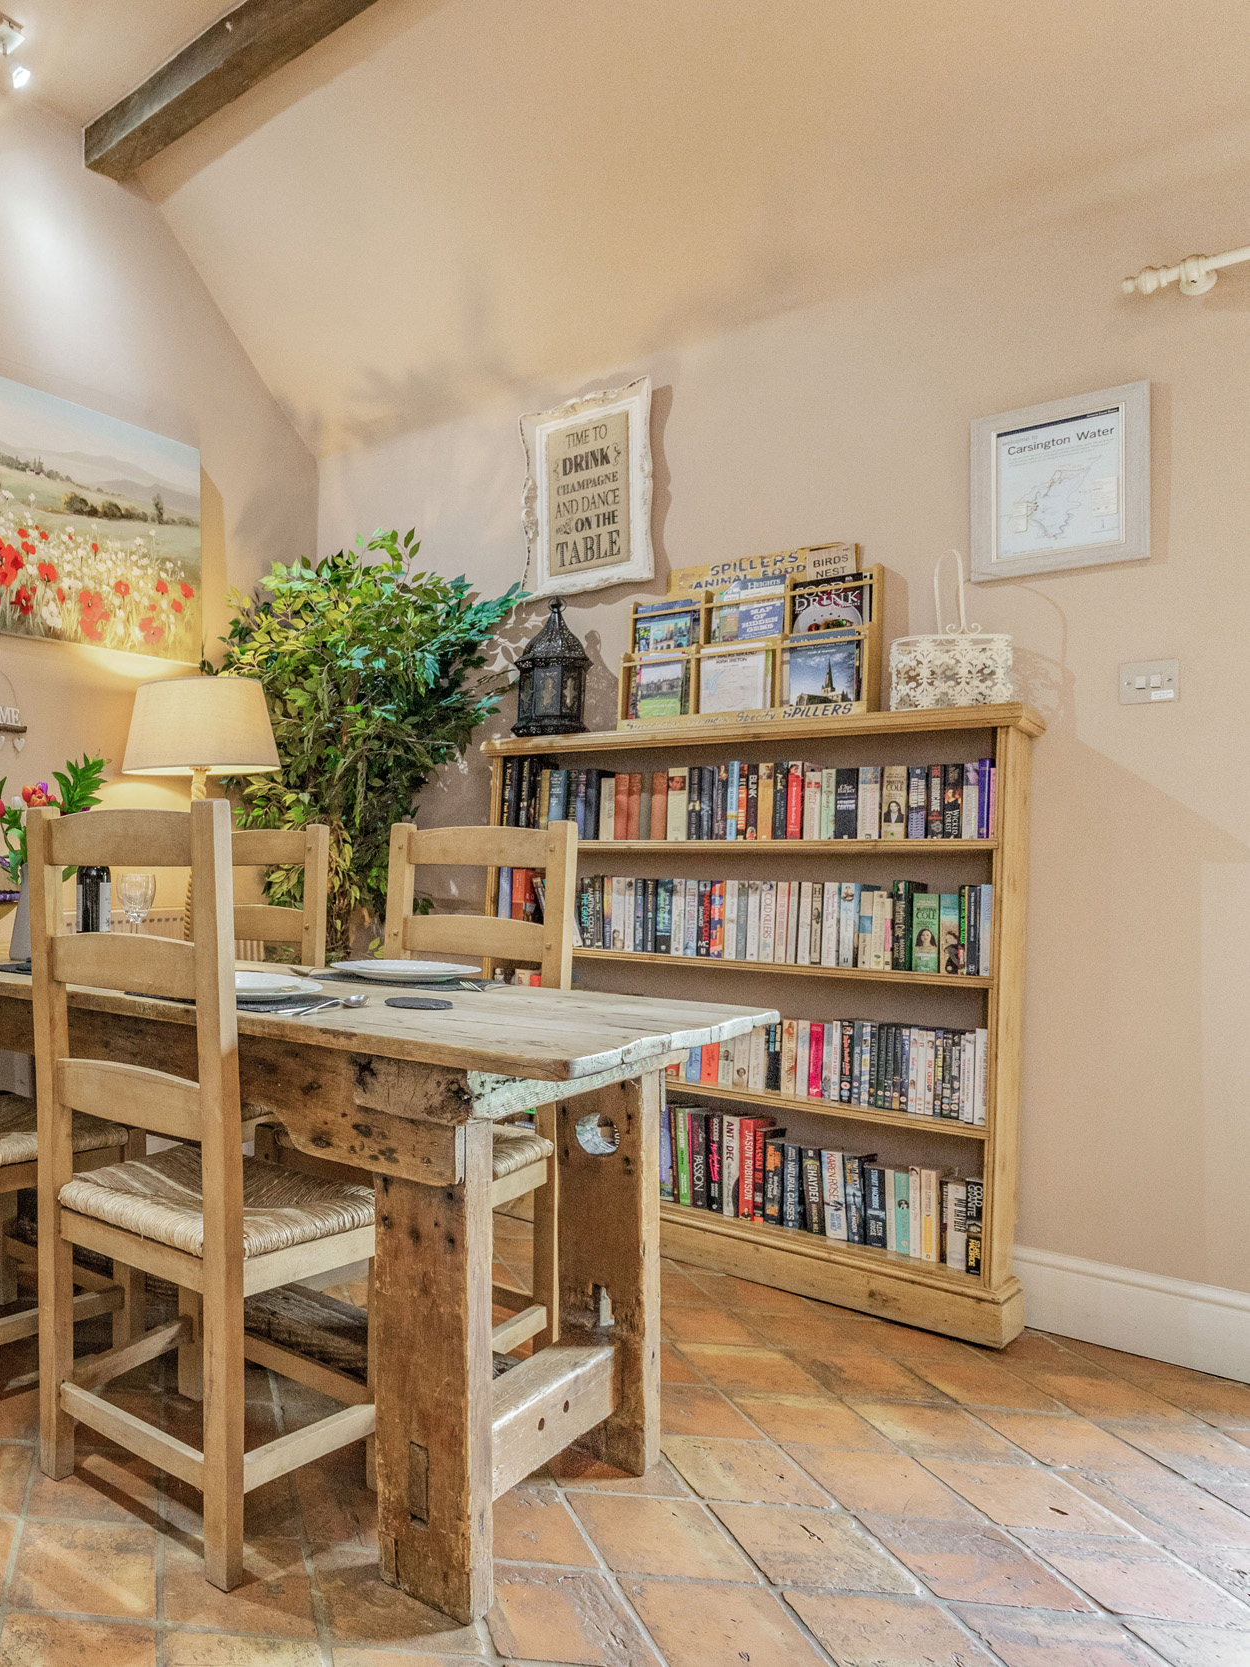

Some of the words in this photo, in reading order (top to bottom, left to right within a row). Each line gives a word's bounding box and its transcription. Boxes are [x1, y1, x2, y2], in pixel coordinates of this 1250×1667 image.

[566, 428, 590, 449] TIME
[592, 424, 608, 442] TO
[1007, 436, 1071, 456] Carsington
[1076, 427, 1115, 442] Water
[562, 445, 611, 477] DRINK
[557, 471, 618, 496] CHAMPAGNE
[555, 499, 579, 519] AND
[582, 488, 620, 513] DANCE
[575, 516, 592, 533] ON
[595, 509, 618, 529] THE
[556, 529, 621, 568] TABLE
[710, 551, 799, 576] SPILLERS
[813, 554, 849, 568] BIRDS
[816, 566, 847, 579] NEST
[750, 606, 773, 615] MAP
[795, 590, 861, 610] DRINK
[741, 616, 779, 629] HIDDEN
[746, 623, 774, 633] GEMS
[782, 703, 854, 719] SPILLERS
[504, 768, 512, 784] Royal
[748, 775, 757, 798] BLINK
[886, 784, 904, 792] COLE
[910, 778, 918, 808] KELLERMAN
[931, 778, 941, 812] HURRICANE
[945, 811, 953, 833] FOREST
[951, 809, 960, 835] WICKED
[581, 893, 589, 905] THE
[587, 887, 595, 915] MARTINA
[687, 888, 697, 909] LITTLE
[703, 893, 711, 921] MARTINA
[763, 893, 773, 914] COLD
[581, 906, 589, 928] GRAFT
[687, 909, 696, 926] GIRLS
[895, 901, 906, 923] Martina
[916, 911, 937, 920] COLE
[587, 915, 595, 932] COLE
[702, 923, 710, 941] COLE
[762, 914, 772, 939] KILLERS
[895, 924, 906, 938] Cole
[686, 927, 695, 943] LOST
[726, 1121, 735, 1139] ANT
[726, 1145, 734, 1161] DEC
[744, 1130, 754, 1157] JASON
[693, 1155, 704, 1192] PASSION
[787, 1161, 796, 1192] NATURAL
[827, 1153, 837, 1178] KAREN
[744, 1160, 753, 1200] ROBINSON
[807, 1170, 819, 1203] HAYDER
[871, 1169, 879, 1186] STUART
[828, 1178, 840, 1200] ROSE
[871, 1186, 880, 1209] MACBRIDE
[975, 1186, 983, 1207] COLD
[786, 1192, 795, 1221] CAUSES
[967, 1184, 977, 1217] GRANITE
[869, 1220, 877, 1236] HOUSE
[954, 1209, 967, 1234] HAYDER
[968, 1239, 976, 1267] MACBRIDE
